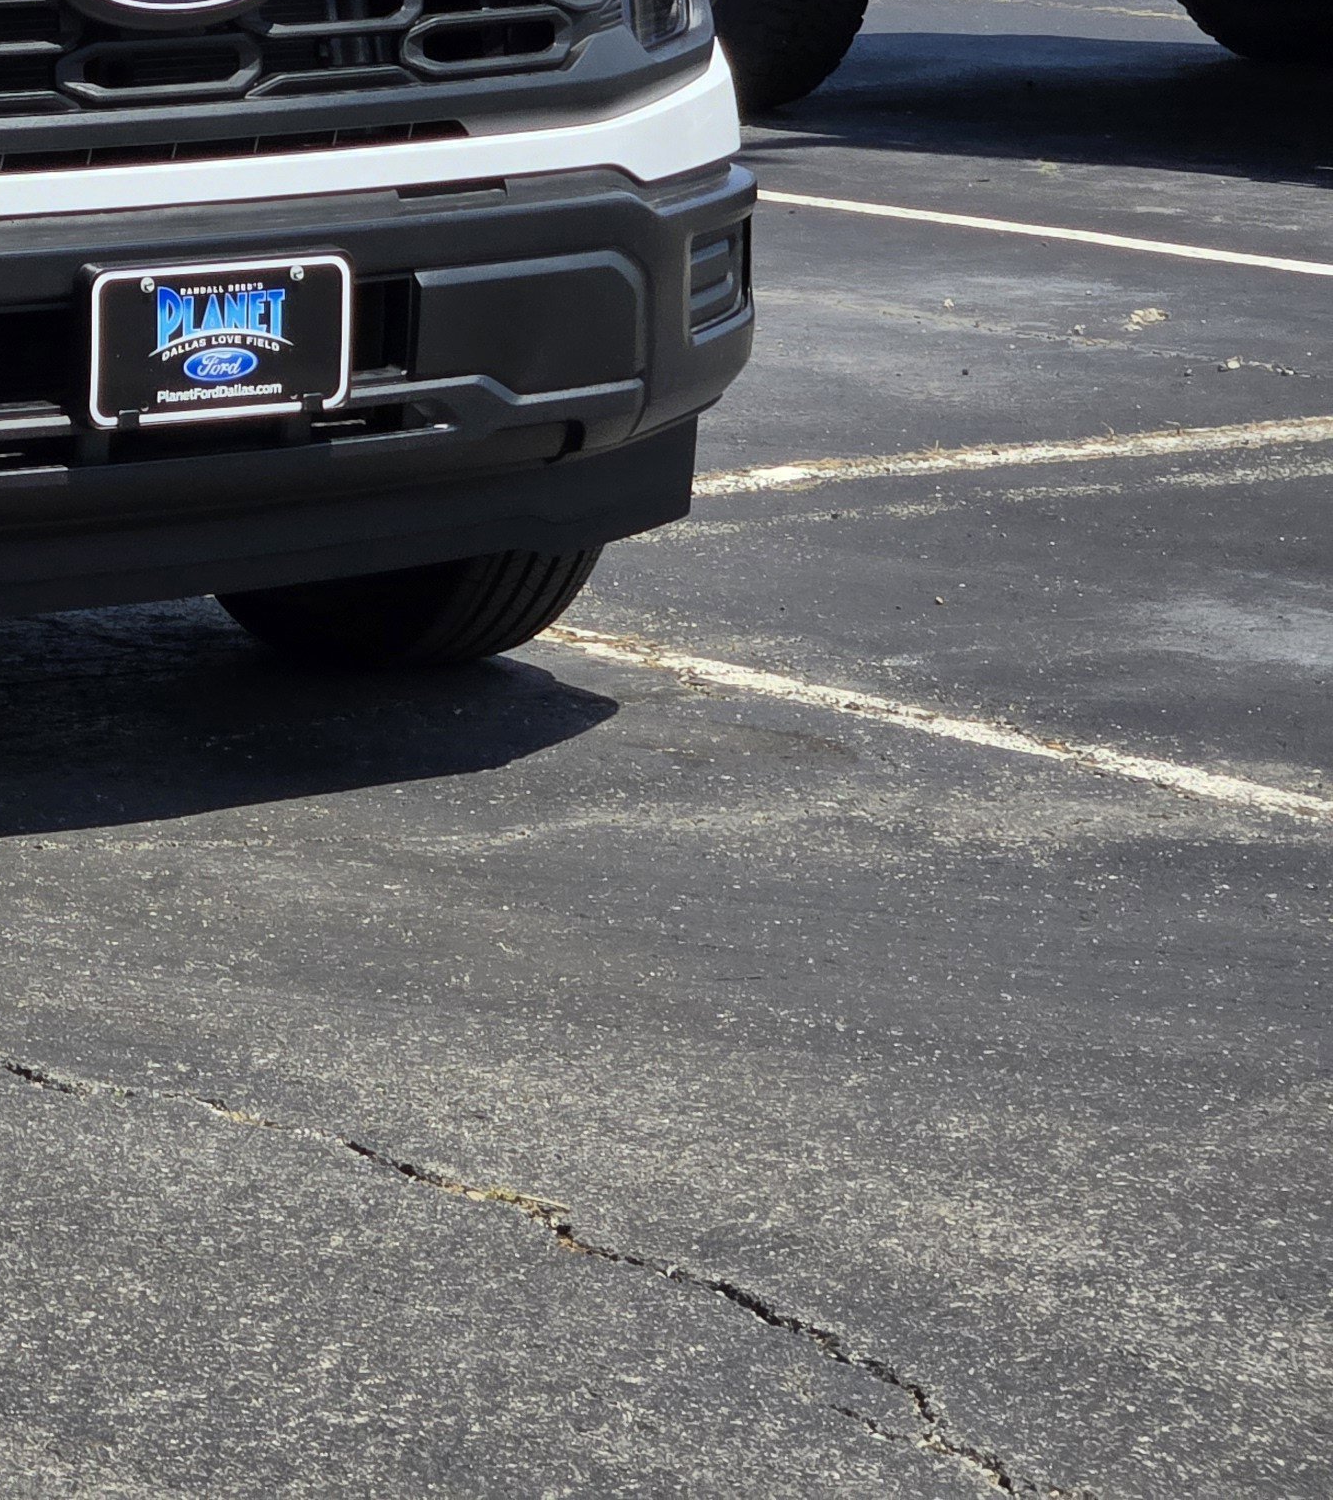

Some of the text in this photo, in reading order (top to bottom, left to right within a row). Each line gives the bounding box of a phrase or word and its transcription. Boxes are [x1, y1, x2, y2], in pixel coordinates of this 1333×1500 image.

[157, 286, 286, 350] PLANET
[162, 335, 280, 361] DALLAS LOVE FIELD
[197, 352, 242, 377] Ford
[157, 383, 283, 403] PlanetFordDallas.com
